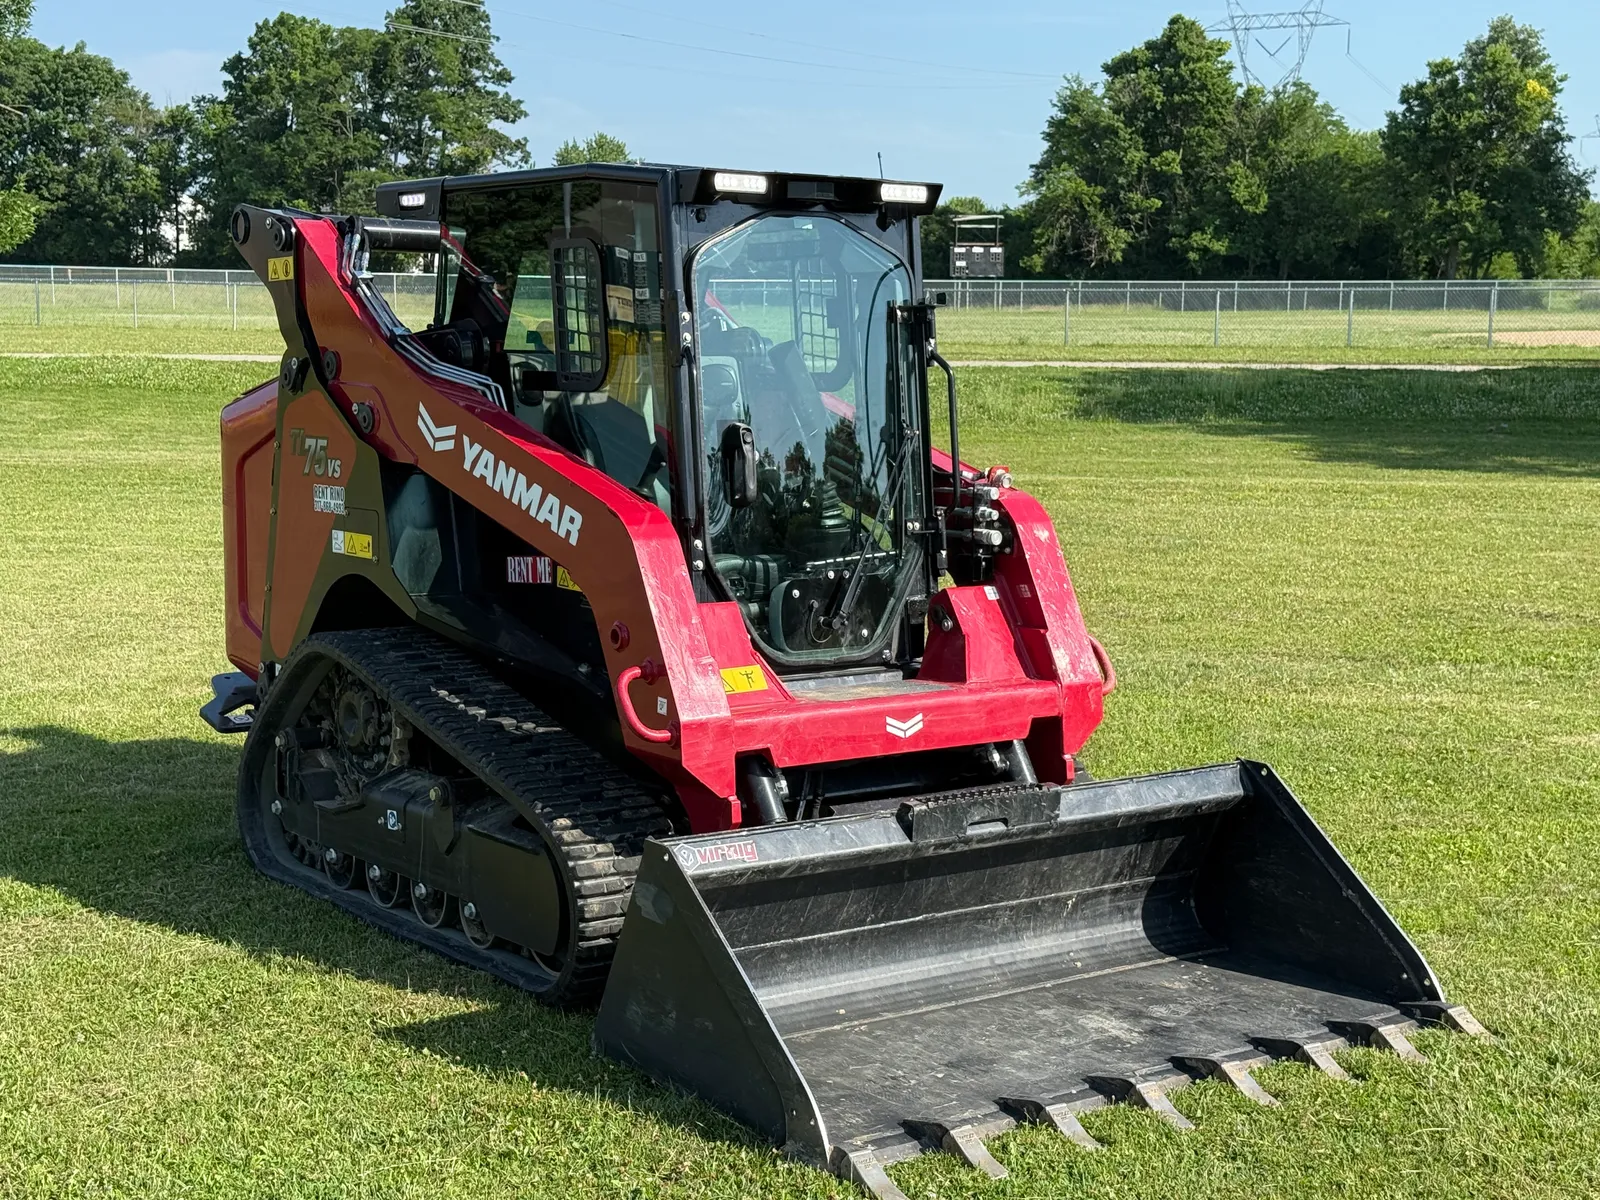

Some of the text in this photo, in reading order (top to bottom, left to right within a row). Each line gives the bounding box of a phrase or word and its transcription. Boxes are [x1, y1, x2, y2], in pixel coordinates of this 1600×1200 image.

[304, 437, 327, 476] 75
[314, 485, 328, 500] RENT
[463, 434, 583, 547] YANMAR
[507, 556, 552, 583] RENT ME
